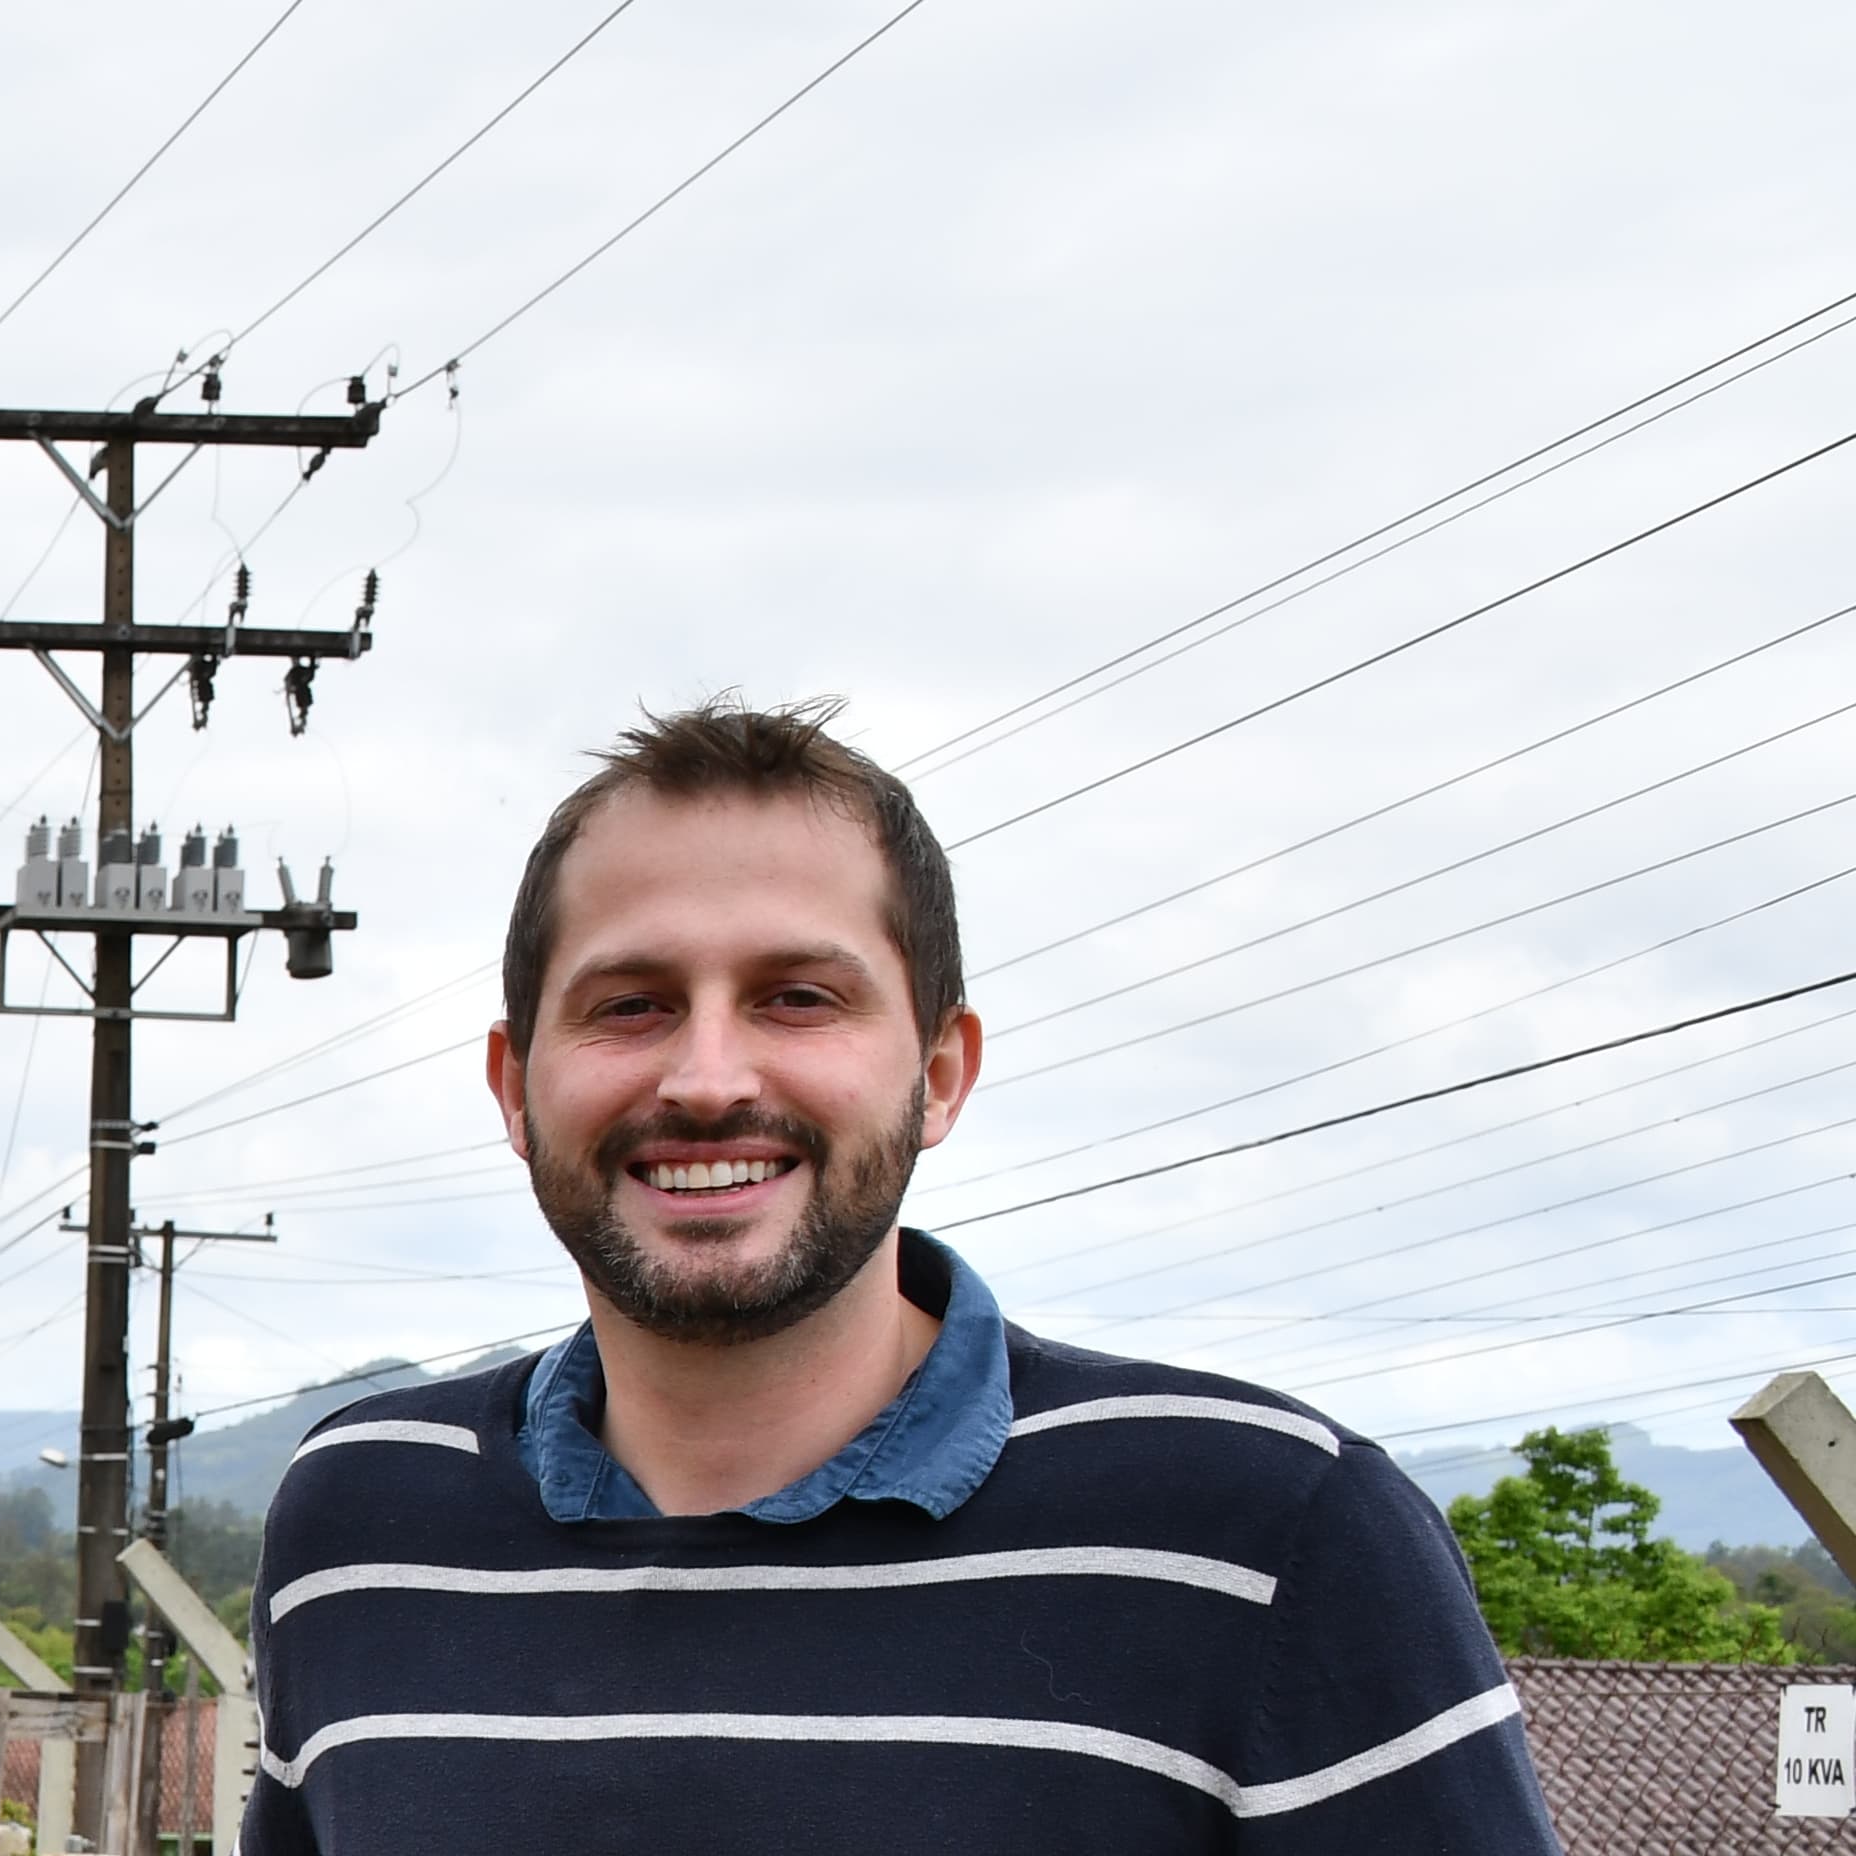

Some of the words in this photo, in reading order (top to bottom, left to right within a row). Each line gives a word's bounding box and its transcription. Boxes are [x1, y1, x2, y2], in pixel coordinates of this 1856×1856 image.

[1804, 1707, 1826, 1733] TR
[1784, 1758, 1802, 1785] 10
[1808, 1758, 1845, 1786] KVA
